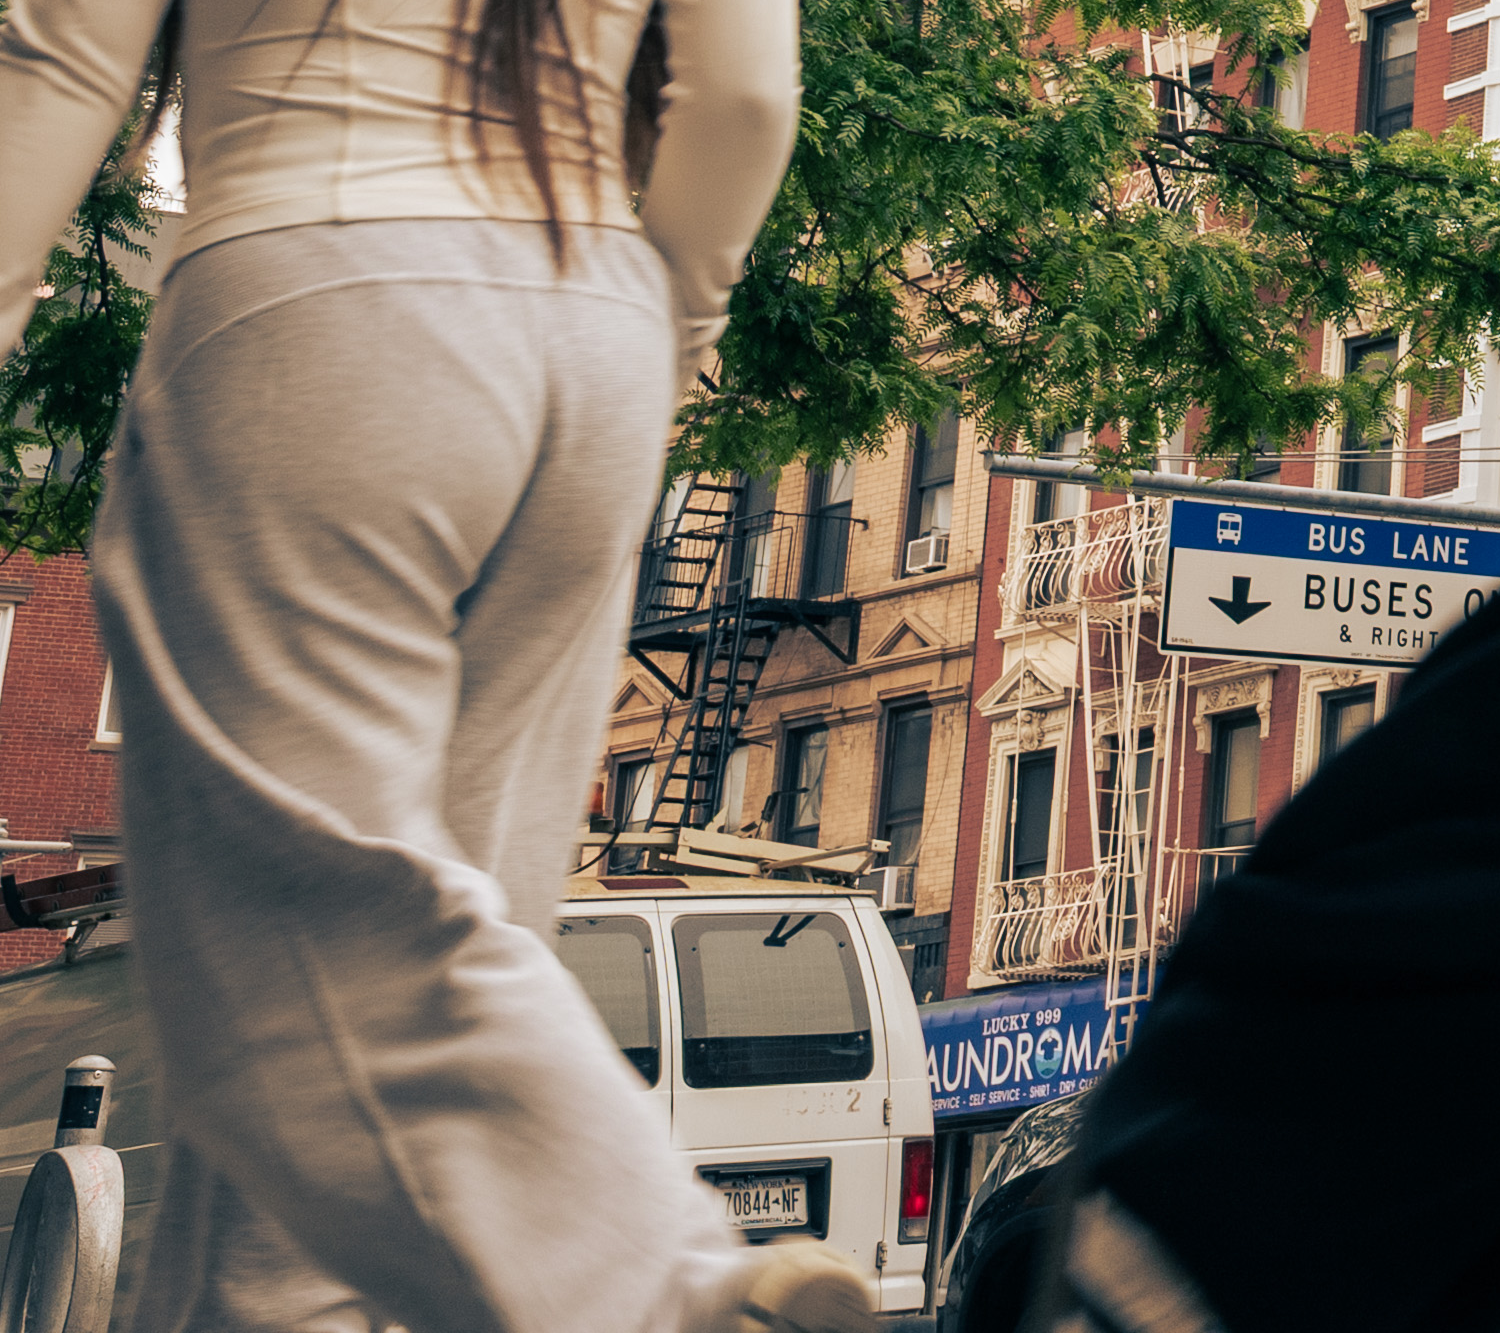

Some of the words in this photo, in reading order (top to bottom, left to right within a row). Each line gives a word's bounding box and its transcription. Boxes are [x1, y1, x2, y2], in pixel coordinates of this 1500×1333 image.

[1308, 522, 1366, 556] BUS
[1393, 531, 1470, 566] LANE
[1304, 573, 1434, 620] BUSES
[1339, 623, 1353, 644] &
[1371, 626, 1439, 650] RIGHT
[982, 1012, 1030, 1036] LUCKY
[1035, 1007, 1062, 1027] 999
[927, 1014, 1139, 1093] AUNDROMAT
[968, 1092, 987, 1107] SELF
[988, 1087, 1021, 1105] SERVICE
[1029, 1083, 1050, 1099] SHIRT
[1059, 1079, 1076, 1095] DRY
[760, 1179, 785, 1190] YORK
[741, 1216, 783, 1226] COMMERCIAL
